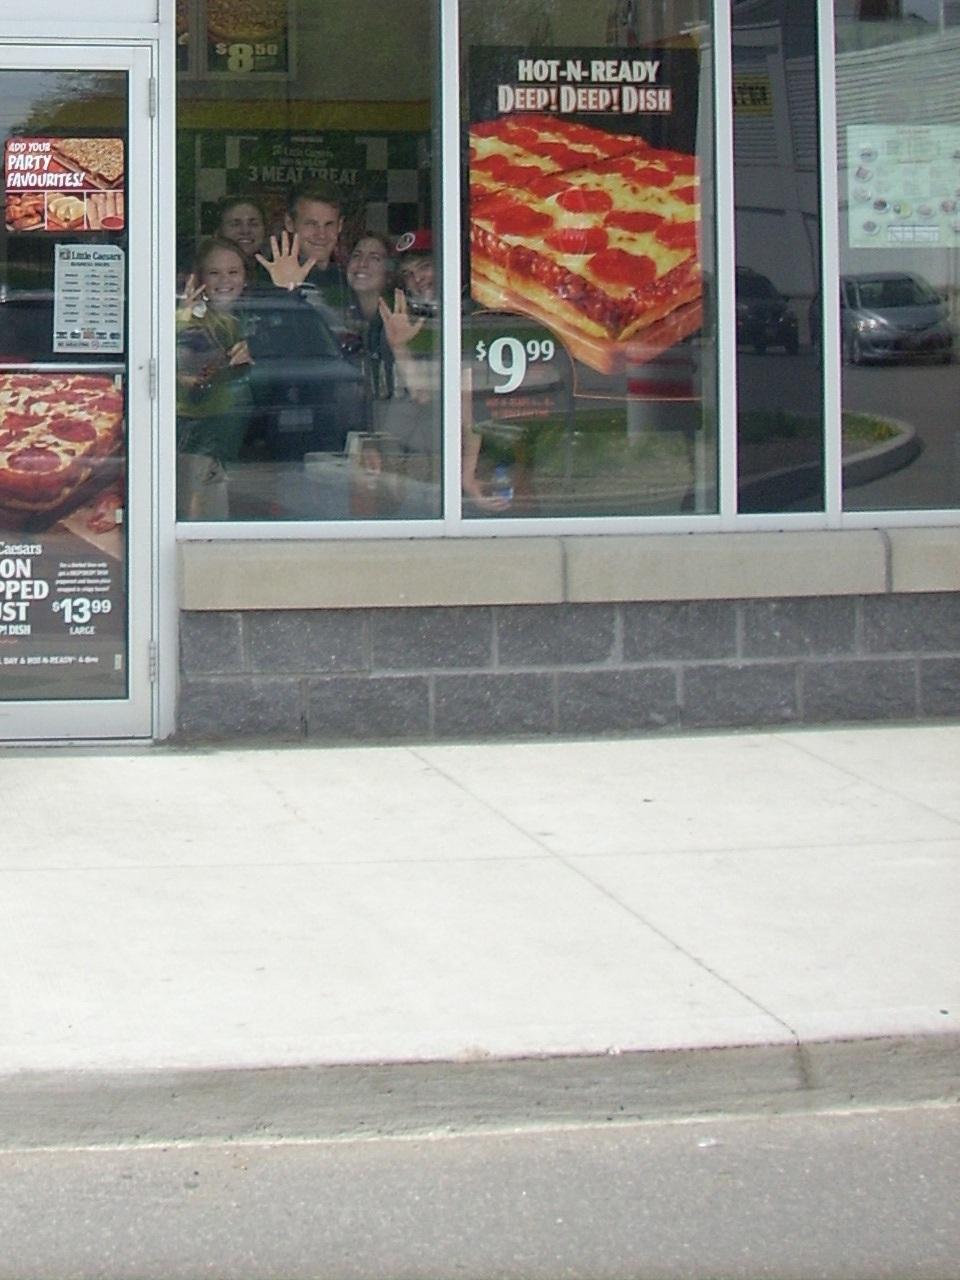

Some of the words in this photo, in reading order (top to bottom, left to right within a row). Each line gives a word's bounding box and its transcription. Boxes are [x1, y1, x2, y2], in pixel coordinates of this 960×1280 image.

[517, 59, 660, 84] HOT-N-READY
[8, 142, 27, 153] ADD
[28, 141, 52, 153] YOUR
[7, 153, 53, 172] PARTY
[6, 171, 86, 188] FAVOURITES!
[262, 166, 305, 184] MEAT
[8, 624, 32, 636] DISH
[69, 626, 96, 636] LARGE
